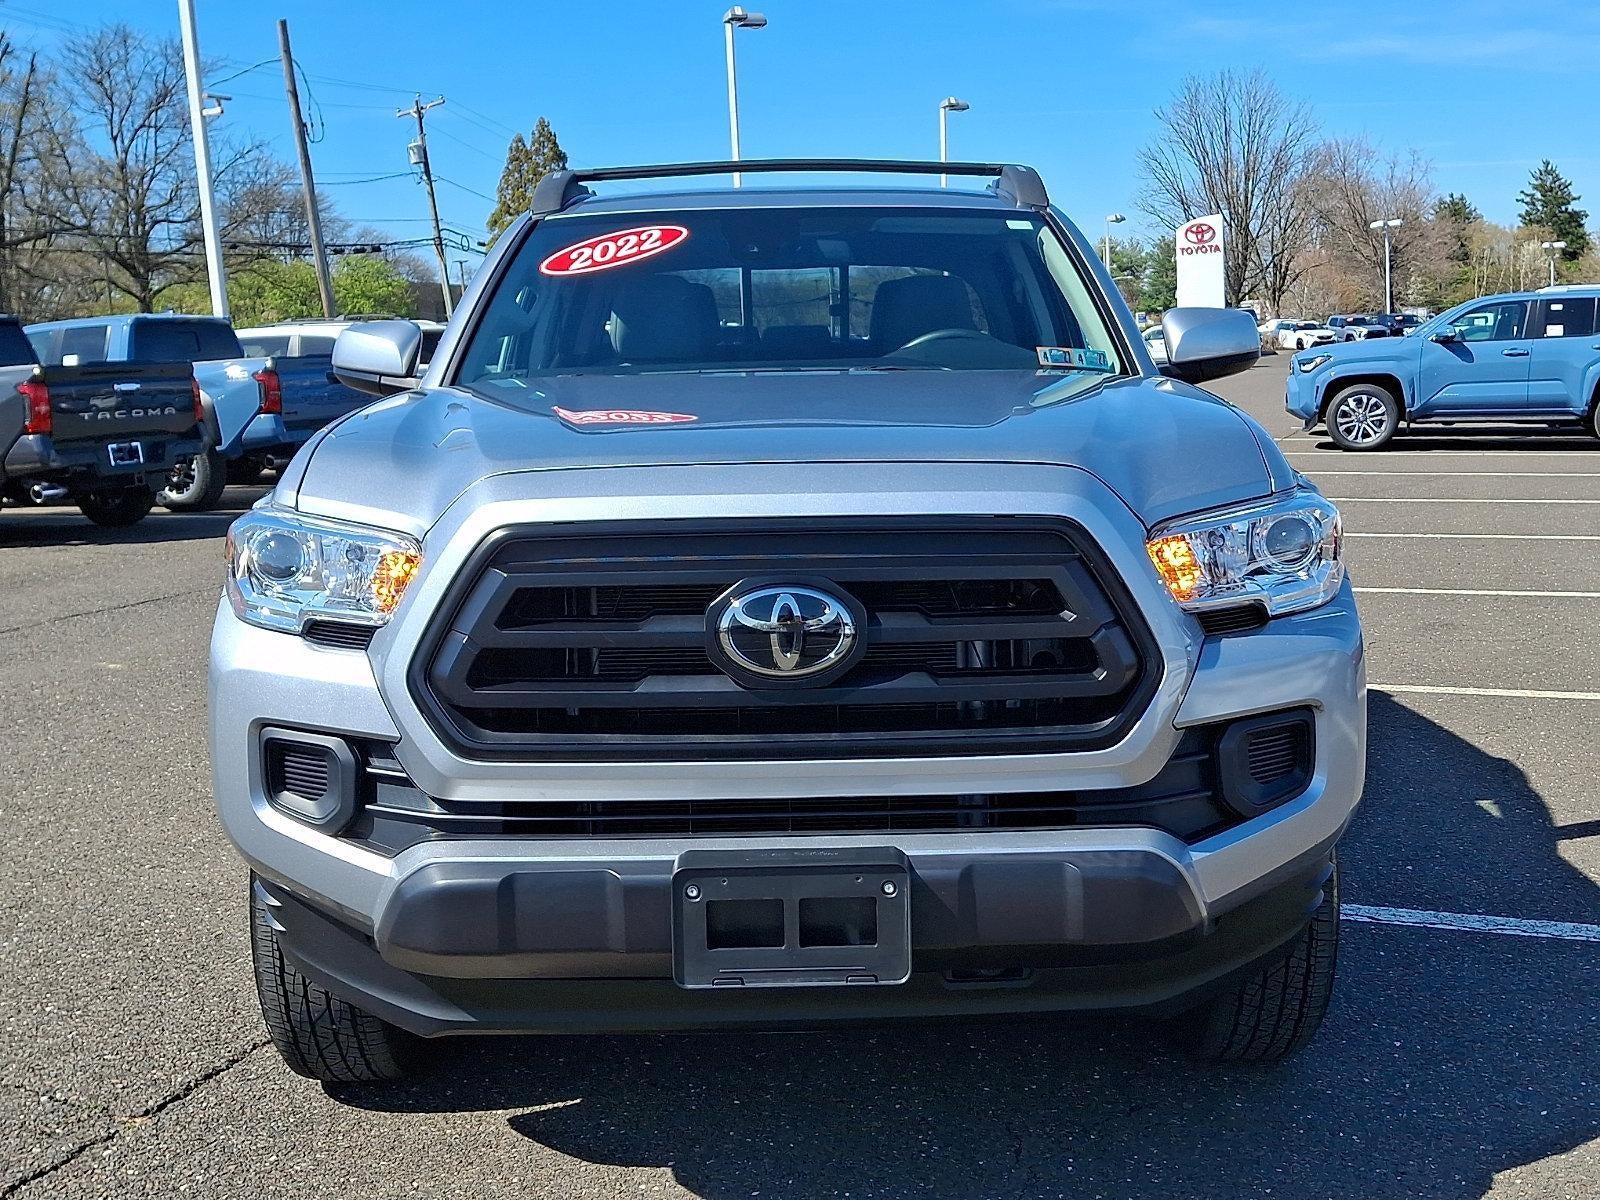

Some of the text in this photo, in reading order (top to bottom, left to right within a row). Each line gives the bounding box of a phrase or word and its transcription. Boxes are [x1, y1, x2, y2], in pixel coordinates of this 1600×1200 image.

[568, 229, 663, 270] 2022
[1180, 244, 1221, 255] TOYOTA
[79, 407, 176, 420] TACOMA
